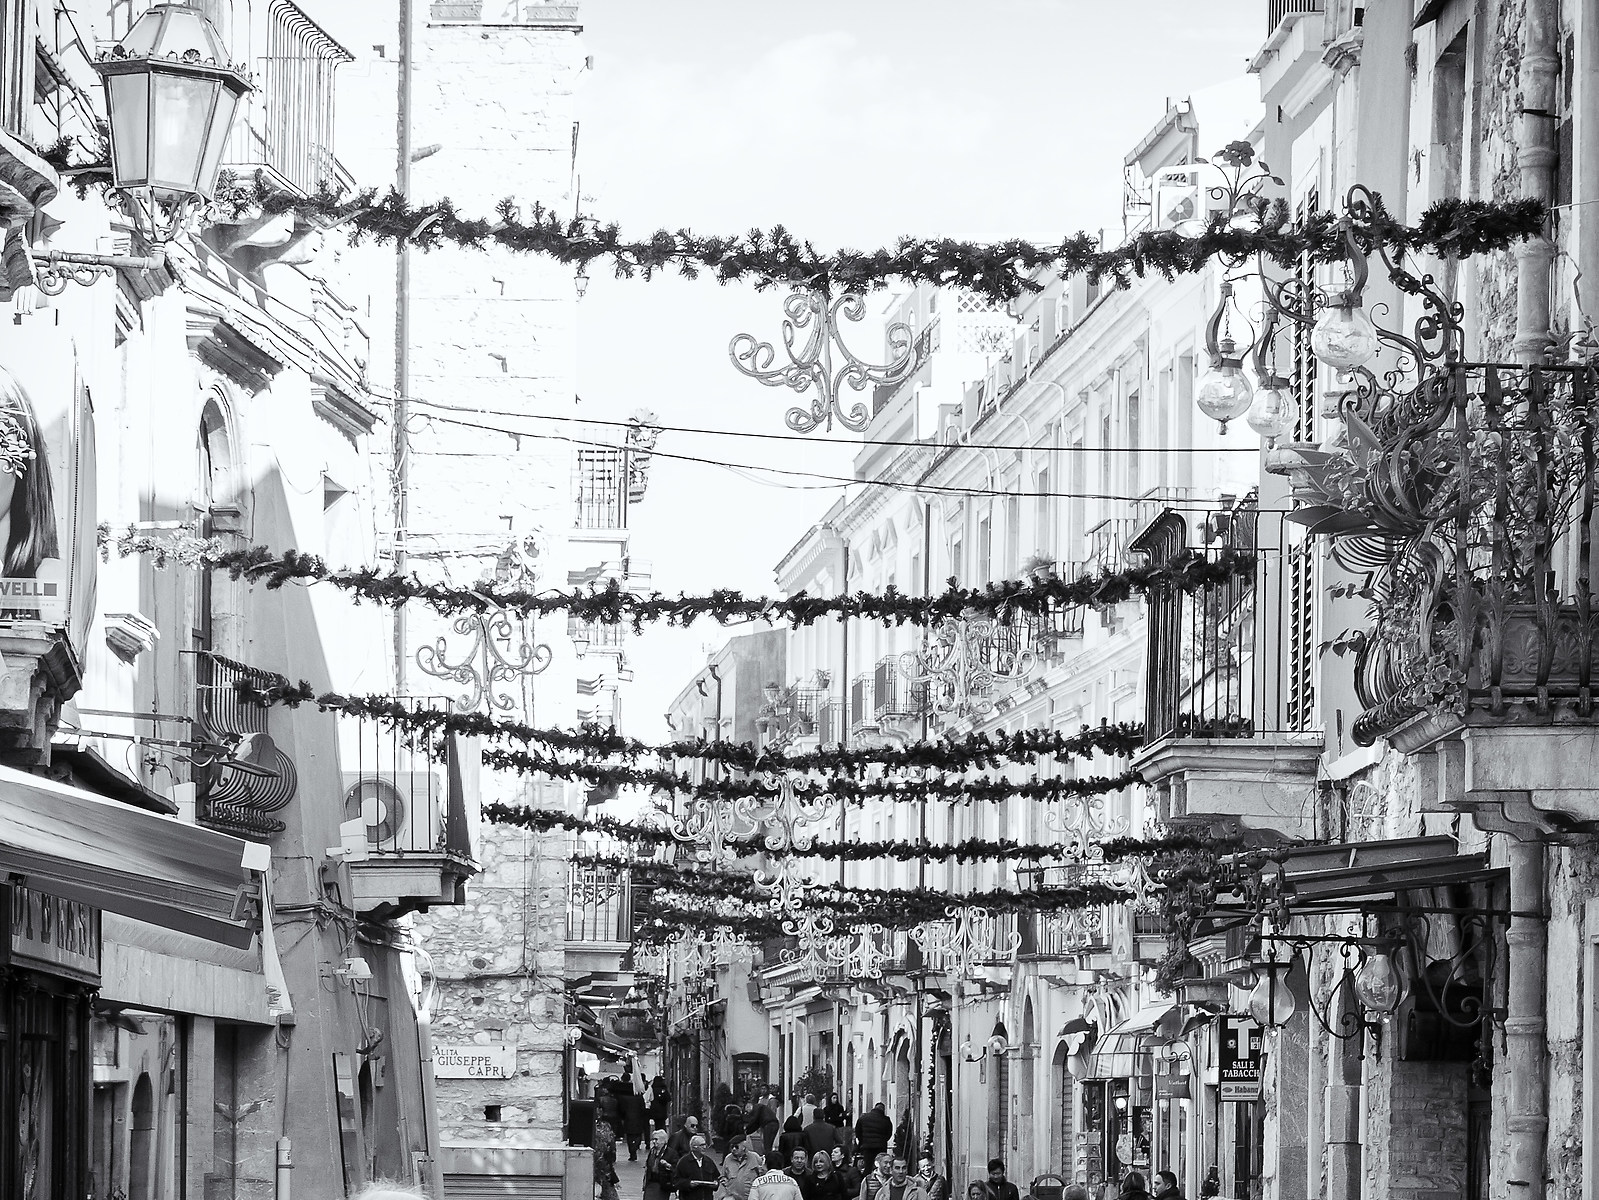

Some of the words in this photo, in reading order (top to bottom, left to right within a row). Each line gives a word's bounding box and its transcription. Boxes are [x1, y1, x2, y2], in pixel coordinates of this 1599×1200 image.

[438, 1056, 491, 1066] GIUSEPPE
[1232, 1061, 1248, 1069] SALI
[1249, 1061, 1255, 1069] E
[468, 1066, 504, 1076] CAPRI
[1222, 1069, 1260, 1078] TABACCH
[1234, 1085, 1258, 1094] Habano
